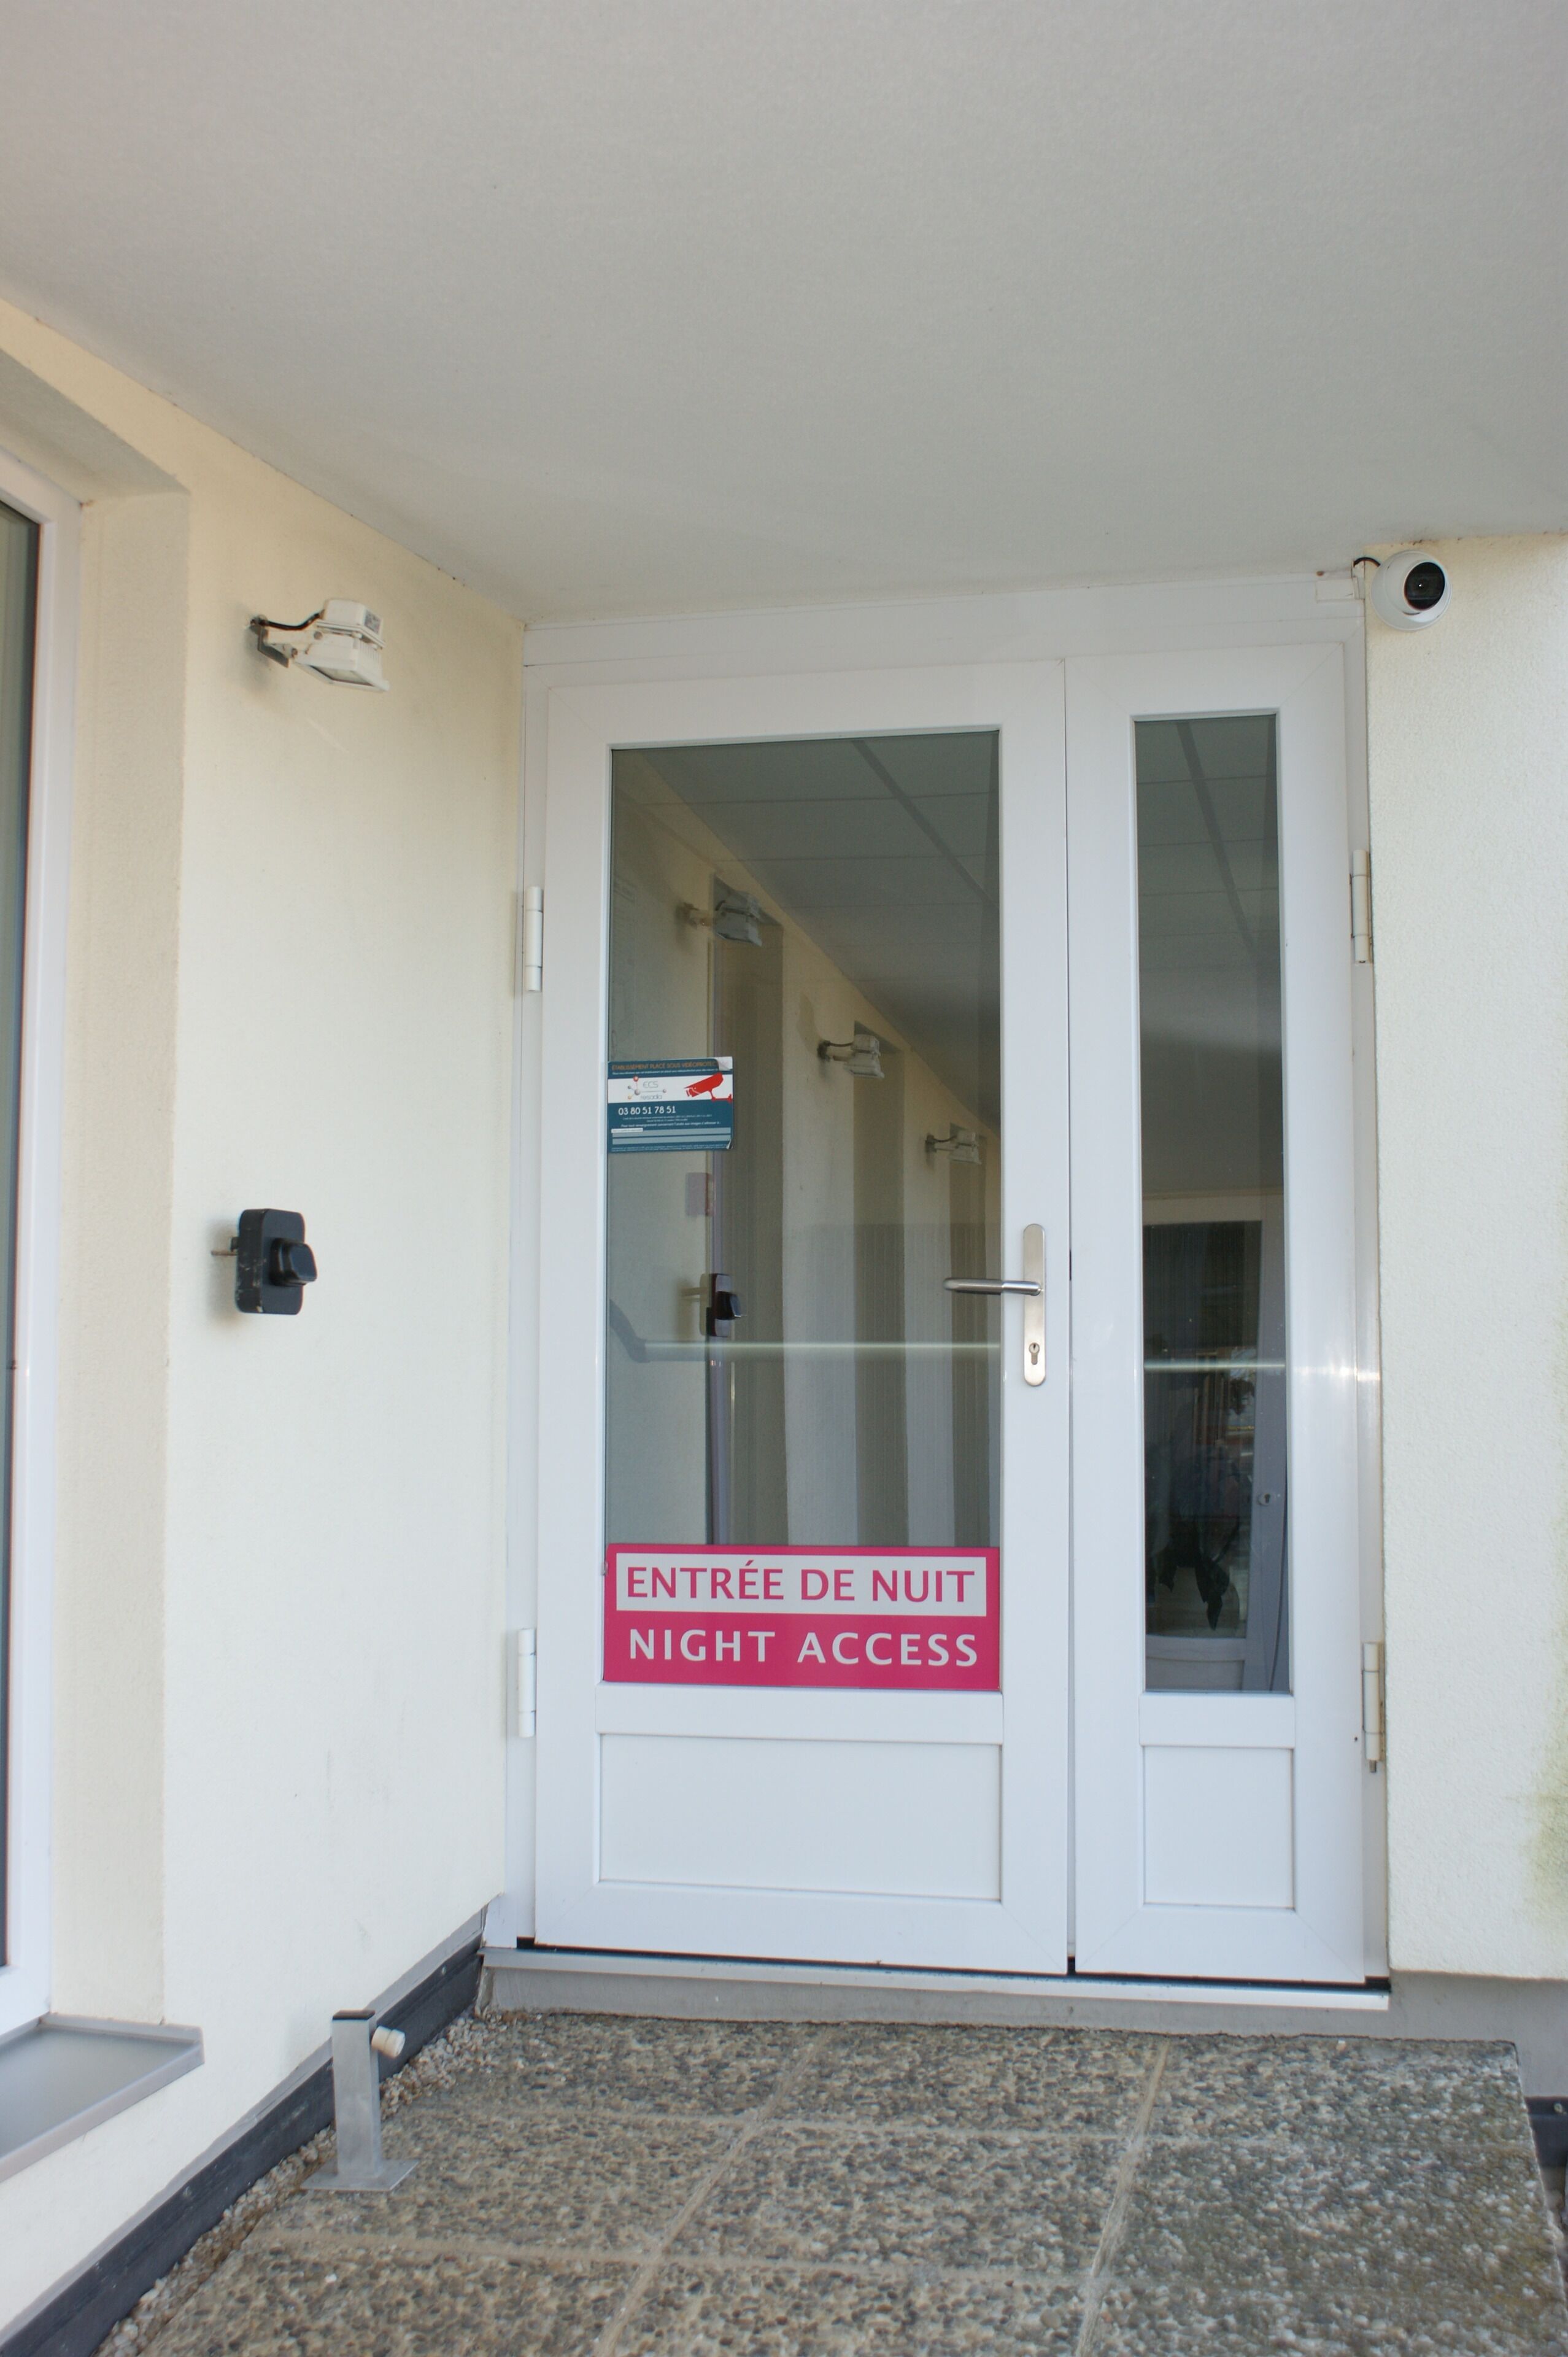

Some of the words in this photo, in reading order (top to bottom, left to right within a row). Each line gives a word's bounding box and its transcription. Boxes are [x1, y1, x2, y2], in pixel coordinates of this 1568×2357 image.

[627, 1560, 784, 1600] ENTRÉE
[801, 1569, 855, 1601] DE
[872, 1569, 975, 1603] NUIT
[630, 1628, 776, 1662] NIGHT
[797, 1631, 978, 1667] ACCESS
